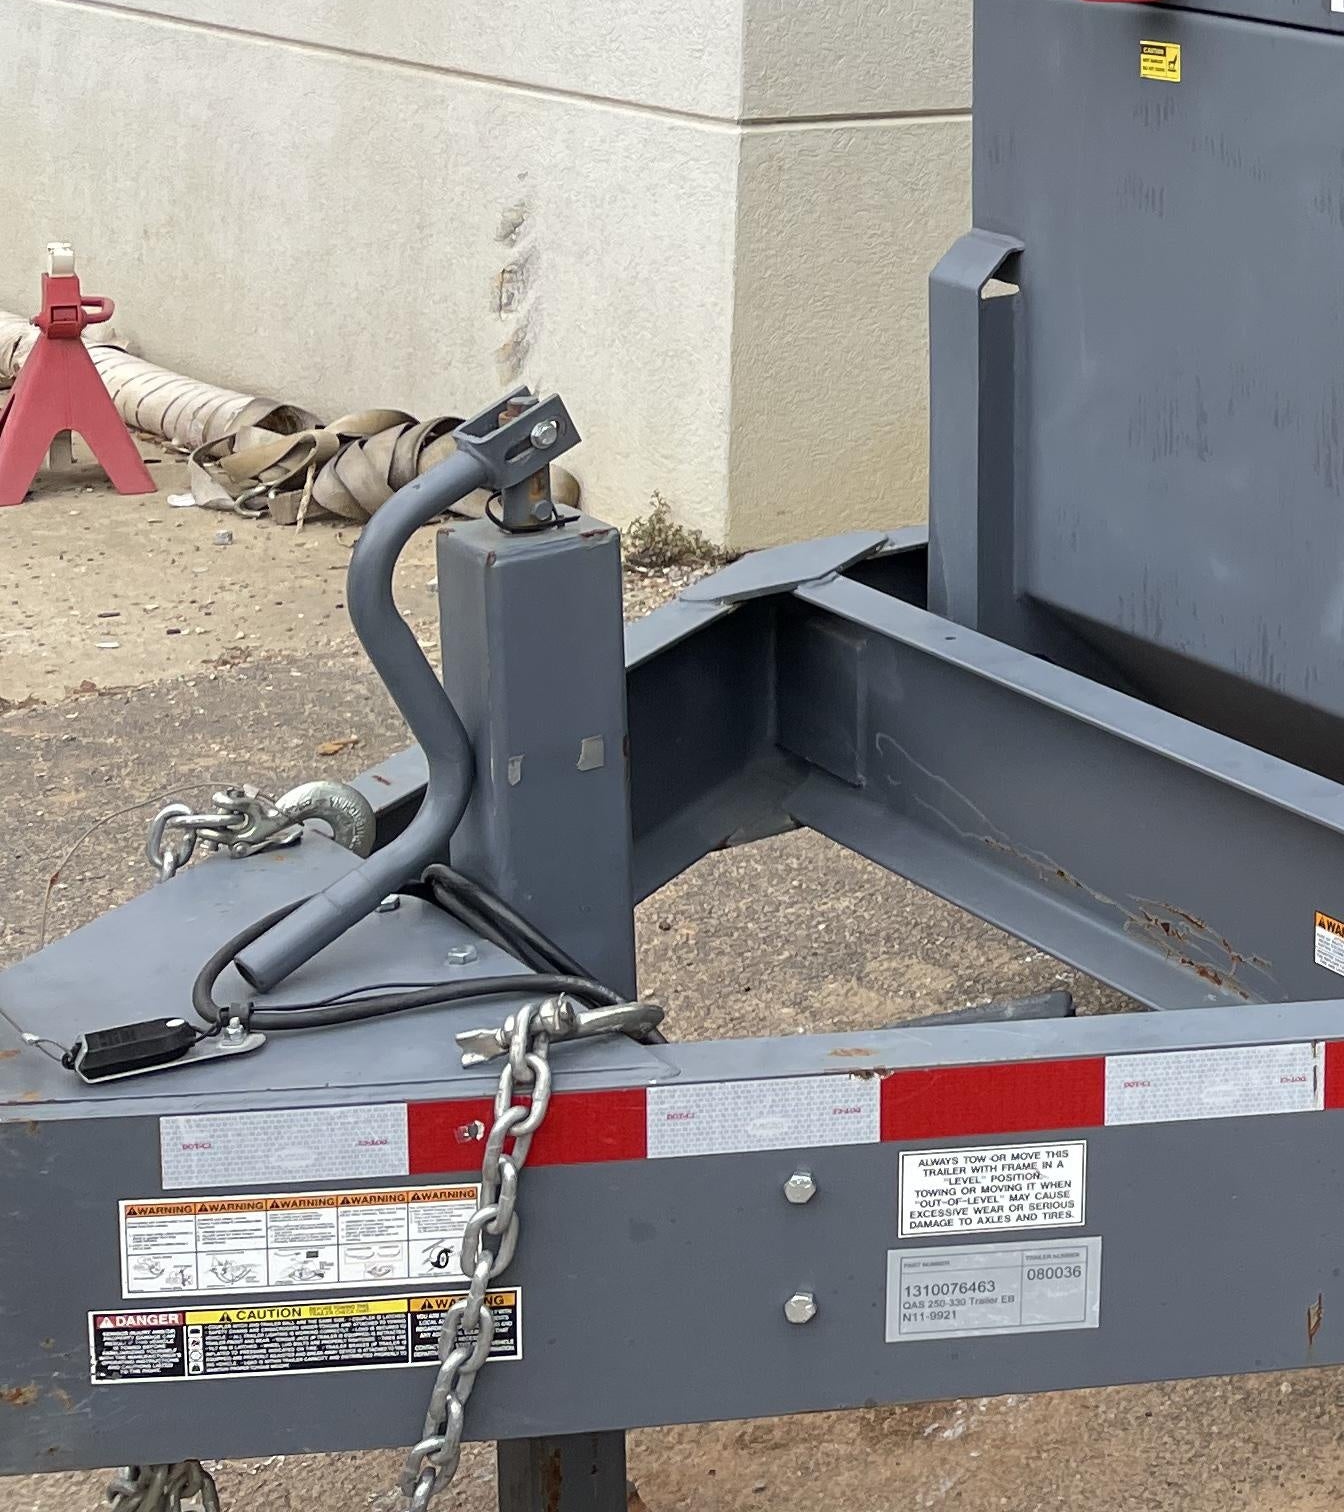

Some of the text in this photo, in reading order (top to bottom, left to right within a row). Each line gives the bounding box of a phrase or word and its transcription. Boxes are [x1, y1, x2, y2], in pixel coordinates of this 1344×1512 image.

[918, 1149, 1069, 1167] ALWAYS TOW OR MOVE THIS
[923, 1159, 1065, 1177] TRAILER WITH FRAME IN A
[421, 1190, 475, 1201] WARNING
[914, 1180, 1072, 1198] TOWING OR MOVING IT WHEN
[1009, 1193, 1031, 1202] MAY
[1034, 1190, 1070, 1201] CAUSE
[280, 1198, 336, 1209] WARNING
[350, 1194, 406, 1205] WARNING
[137, 1205, 194, 1216] WARNING
[209, 1201, 264, 1213] WARNING
[909, 1200, 1075, 1219] EXCESSIVE WEAR OR SERIOUS
[909, 1218, 954, 1229] DAMAGE
[958, 1216, 973, 1226] TO
[976, 1213, 1011, 1225] AXLES
[1015, 1212, 1038, 1222] AND
[1026, 1265, 1082, 1281] 080036
[904, 1280, 996, 1298] 1310076463
[902, 1301, 925, 1310] QAS
[927, 1298, 966, 1308] 250-330
[115, 1313, 180, 1327] DANGER
[236, 1307, 302, 1321] CAUTION
